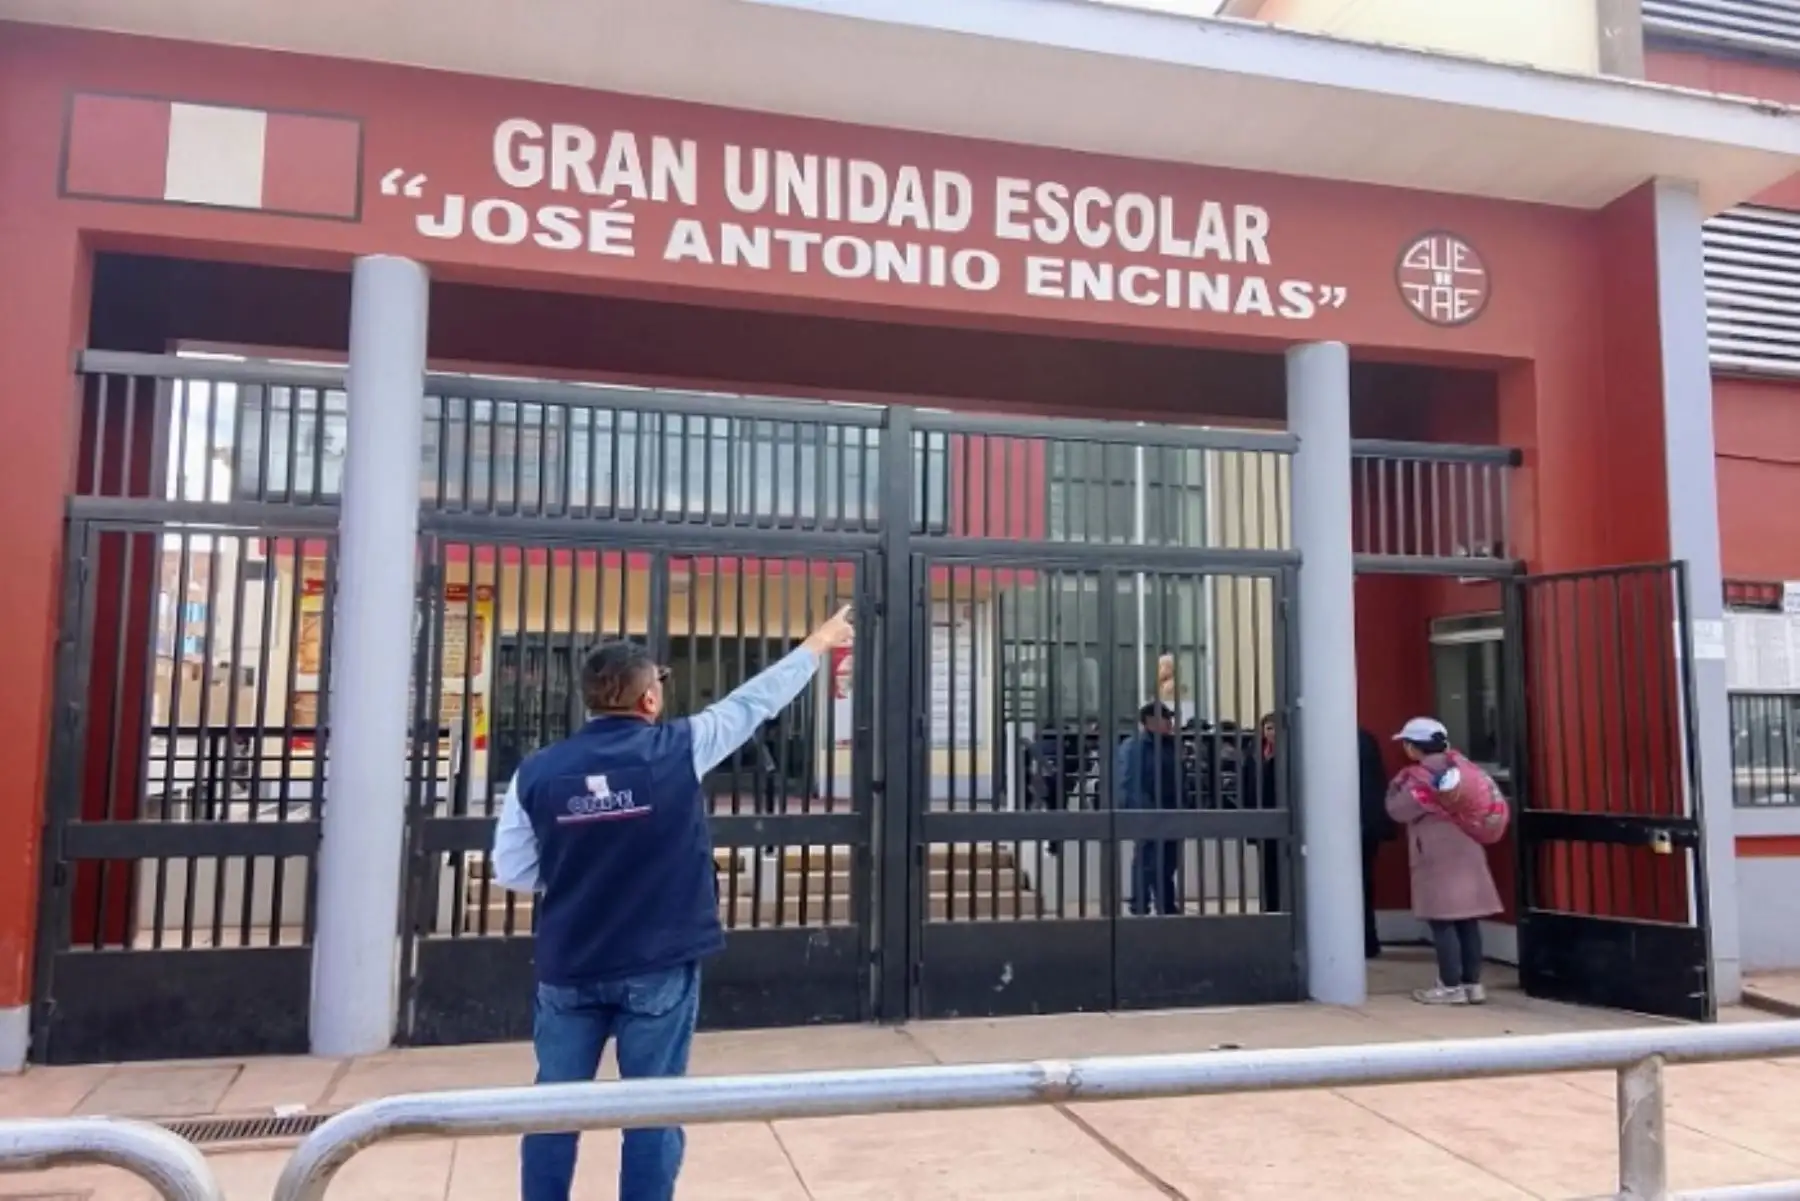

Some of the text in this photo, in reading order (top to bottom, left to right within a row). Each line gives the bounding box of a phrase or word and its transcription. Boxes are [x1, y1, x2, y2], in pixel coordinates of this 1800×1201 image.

[493, 117, 1273, 266] GRAN UNIDAD ESCOLAR
[662, 217, 1002, 292] ANTONIO
[1401, 236, 1484, 275] GUE
